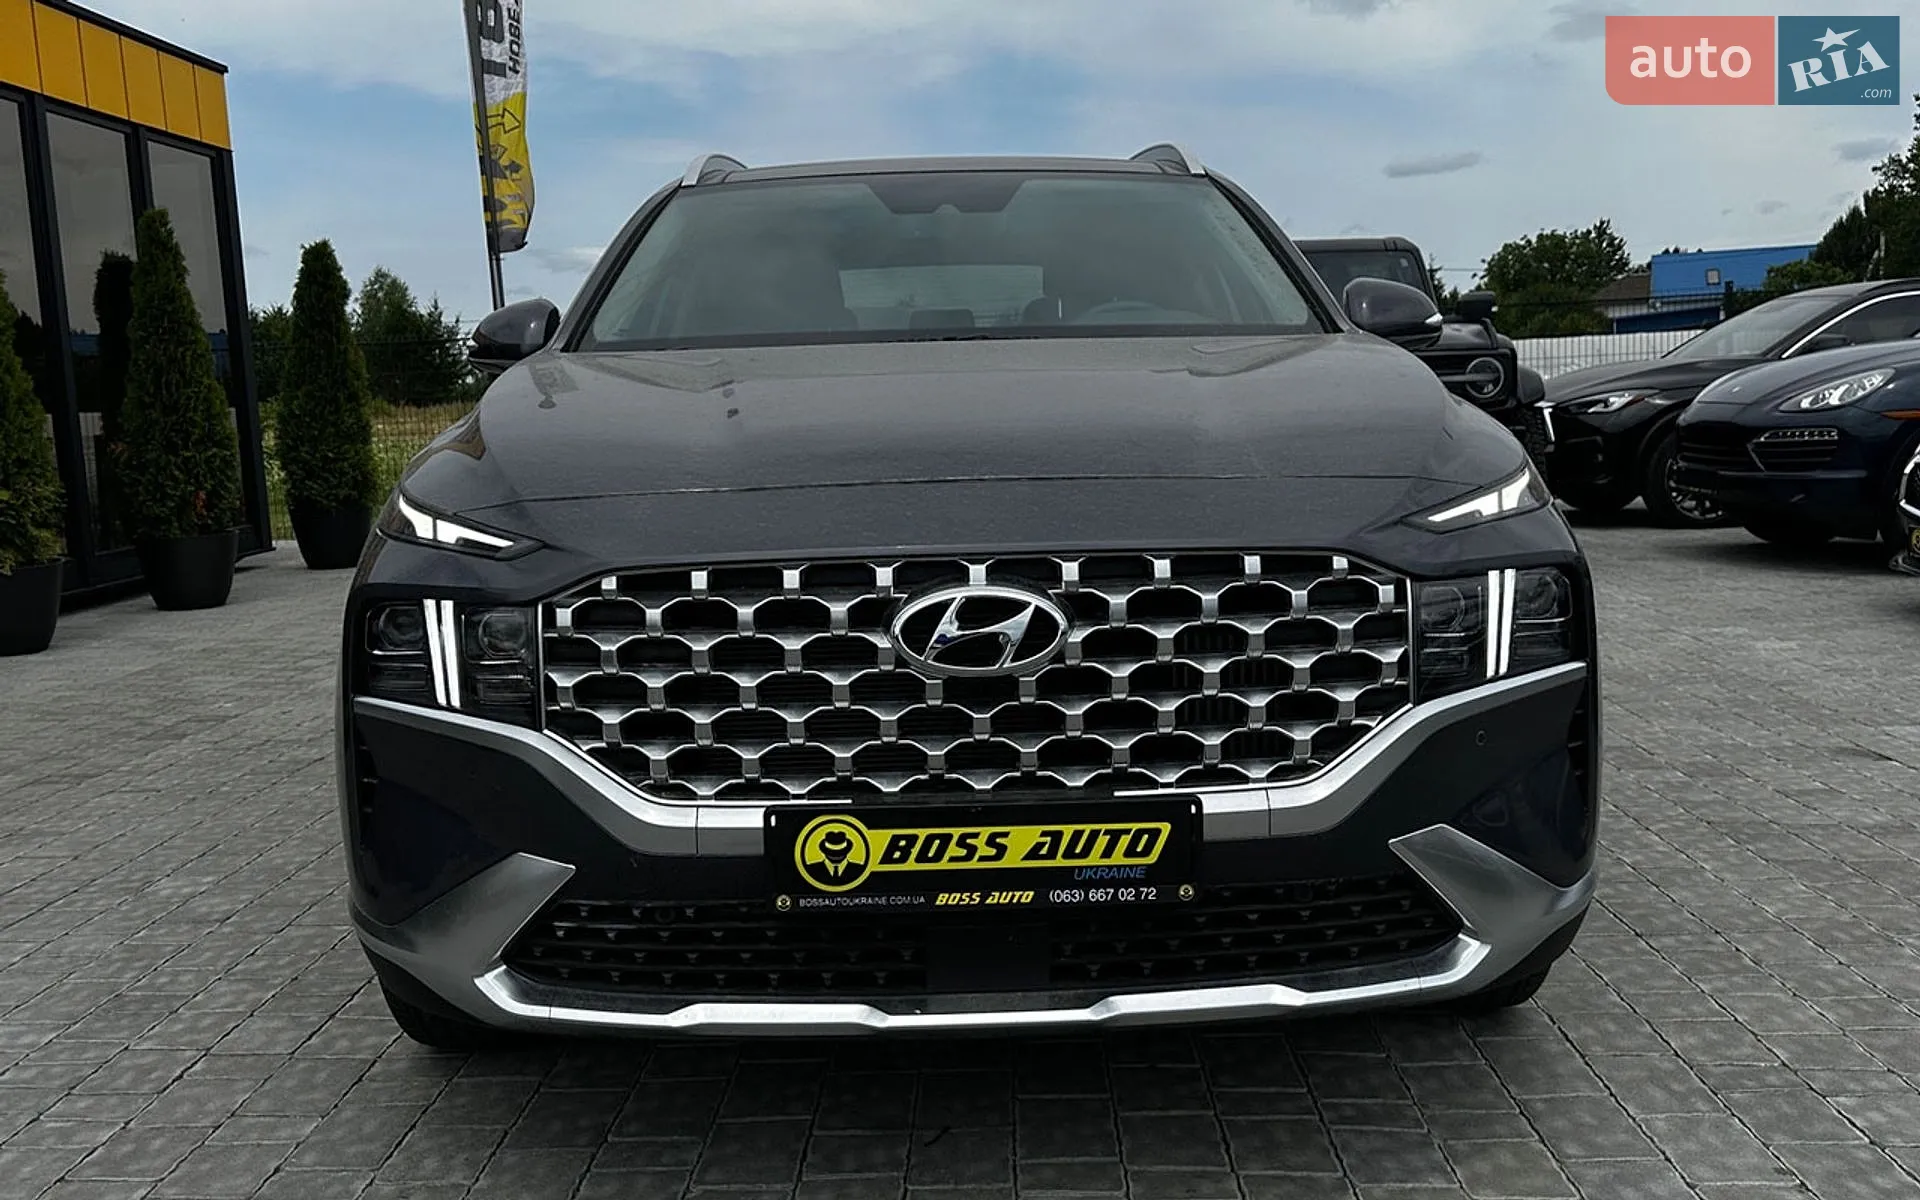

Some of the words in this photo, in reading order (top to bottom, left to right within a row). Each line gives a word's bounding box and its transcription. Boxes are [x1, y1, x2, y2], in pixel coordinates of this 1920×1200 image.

[878, 831, 1011, 865] BOSS
[1020, 827, 1163, 862] AUTO
[1074, 866, 1149, 881] UKRAINE
[935, 892, 981, 906] BOSS
[985, 890, 1035, 905] AUTO
[1049, 889, 1084, 903] (063)
[1088, 888, 1115, 902] 667
[1118, 888, 1136, 901] 02
[1139, 887, 1157, 900] 72
